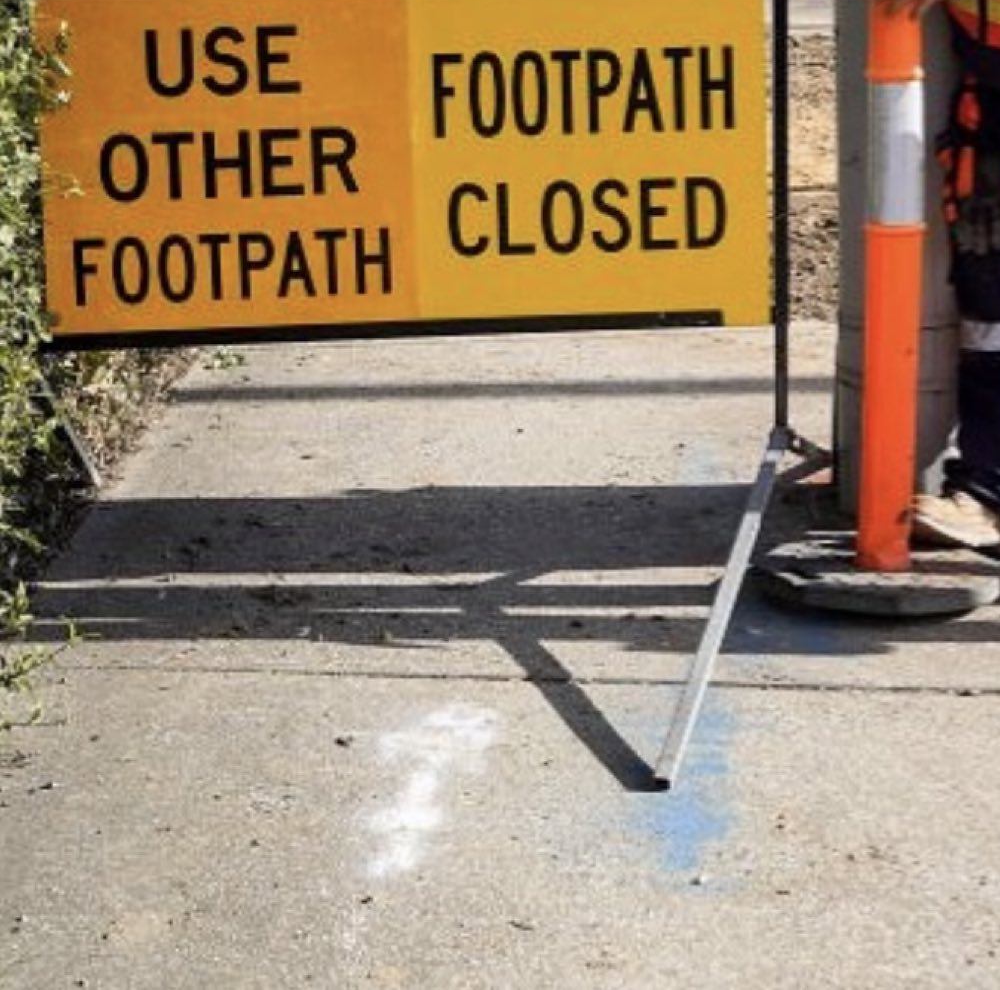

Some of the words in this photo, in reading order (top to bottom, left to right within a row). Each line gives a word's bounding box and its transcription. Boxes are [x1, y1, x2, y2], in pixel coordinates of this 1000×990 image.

[143, 24, 302, 98] USE
[432, 45, 736, 140] FOOTPATH
[99, 126, 360, 204] OTHER
[448, 176, 727, 257] CLOSED
[72, 227, 393, 307] FOOTPATH
